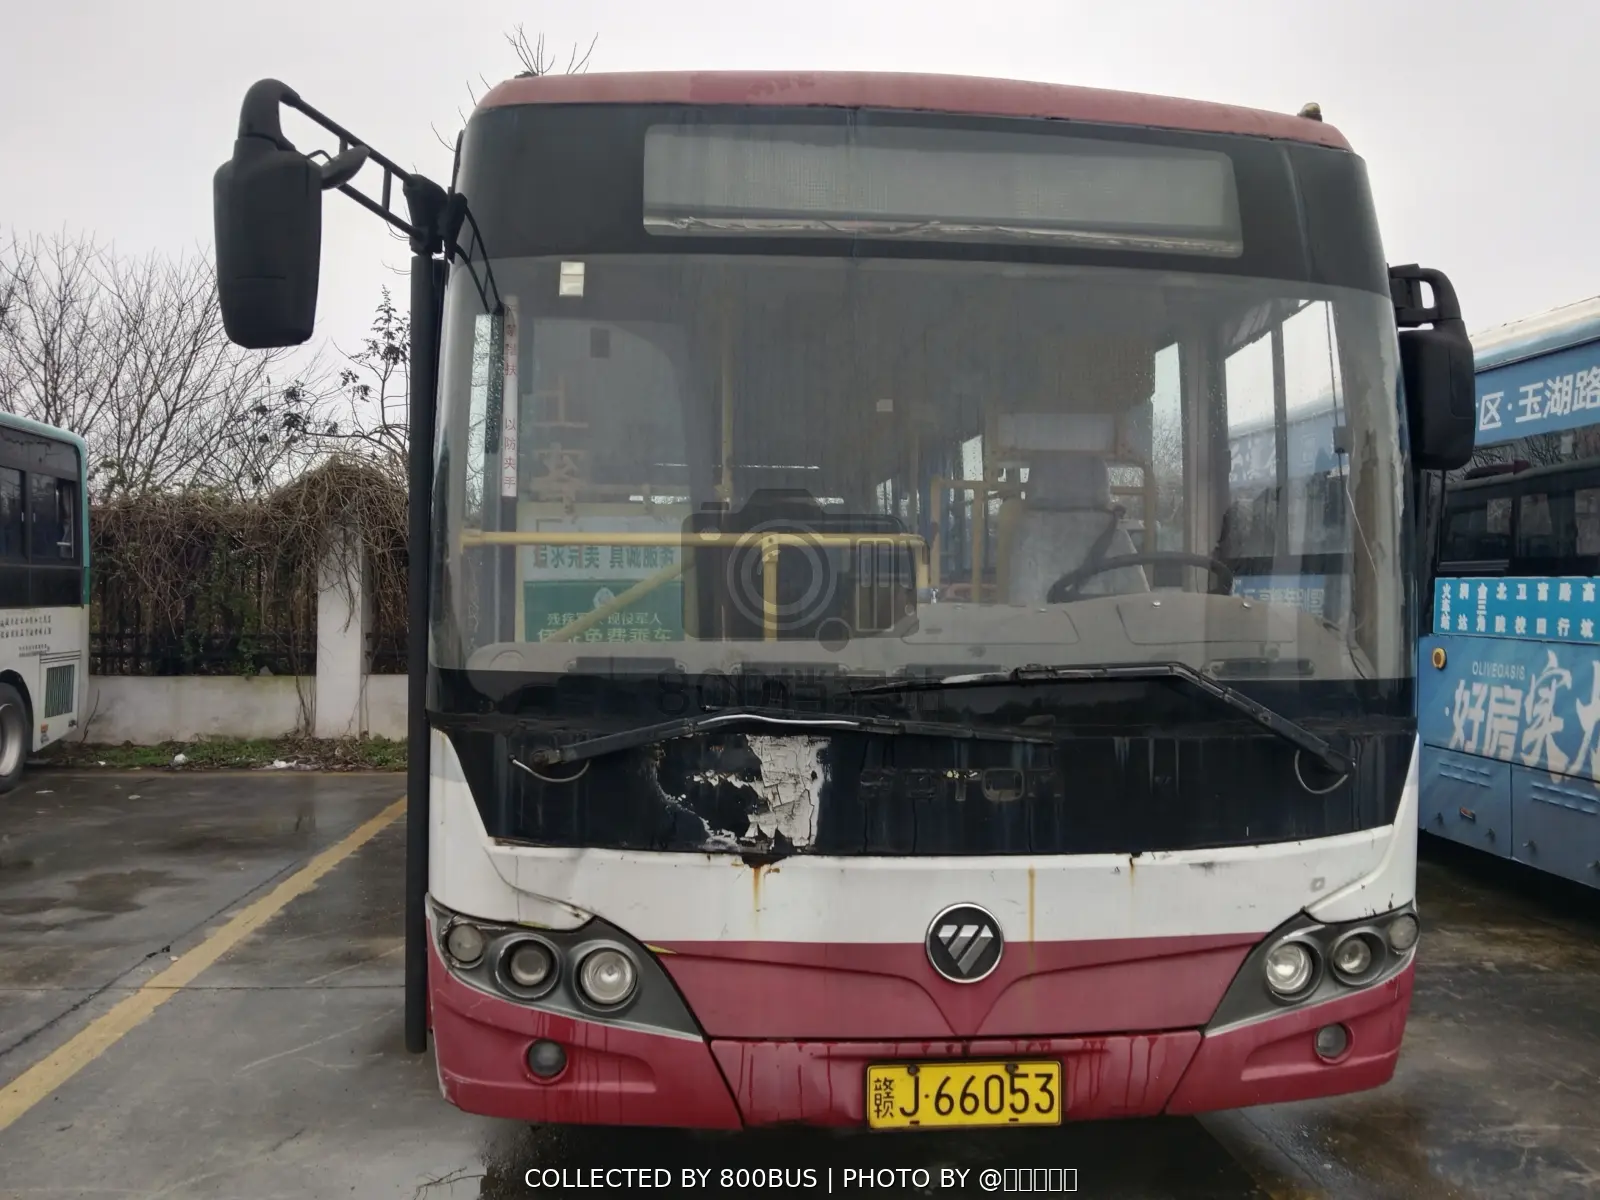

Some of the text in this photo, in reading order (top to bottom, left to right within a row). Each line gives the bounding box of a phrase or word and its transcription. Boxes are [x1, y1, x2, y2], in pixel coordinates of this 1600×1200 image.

[503, 417, 516, 489] 以防夹手
[1472, 661, 1526, 681] OLIVEOASIS
